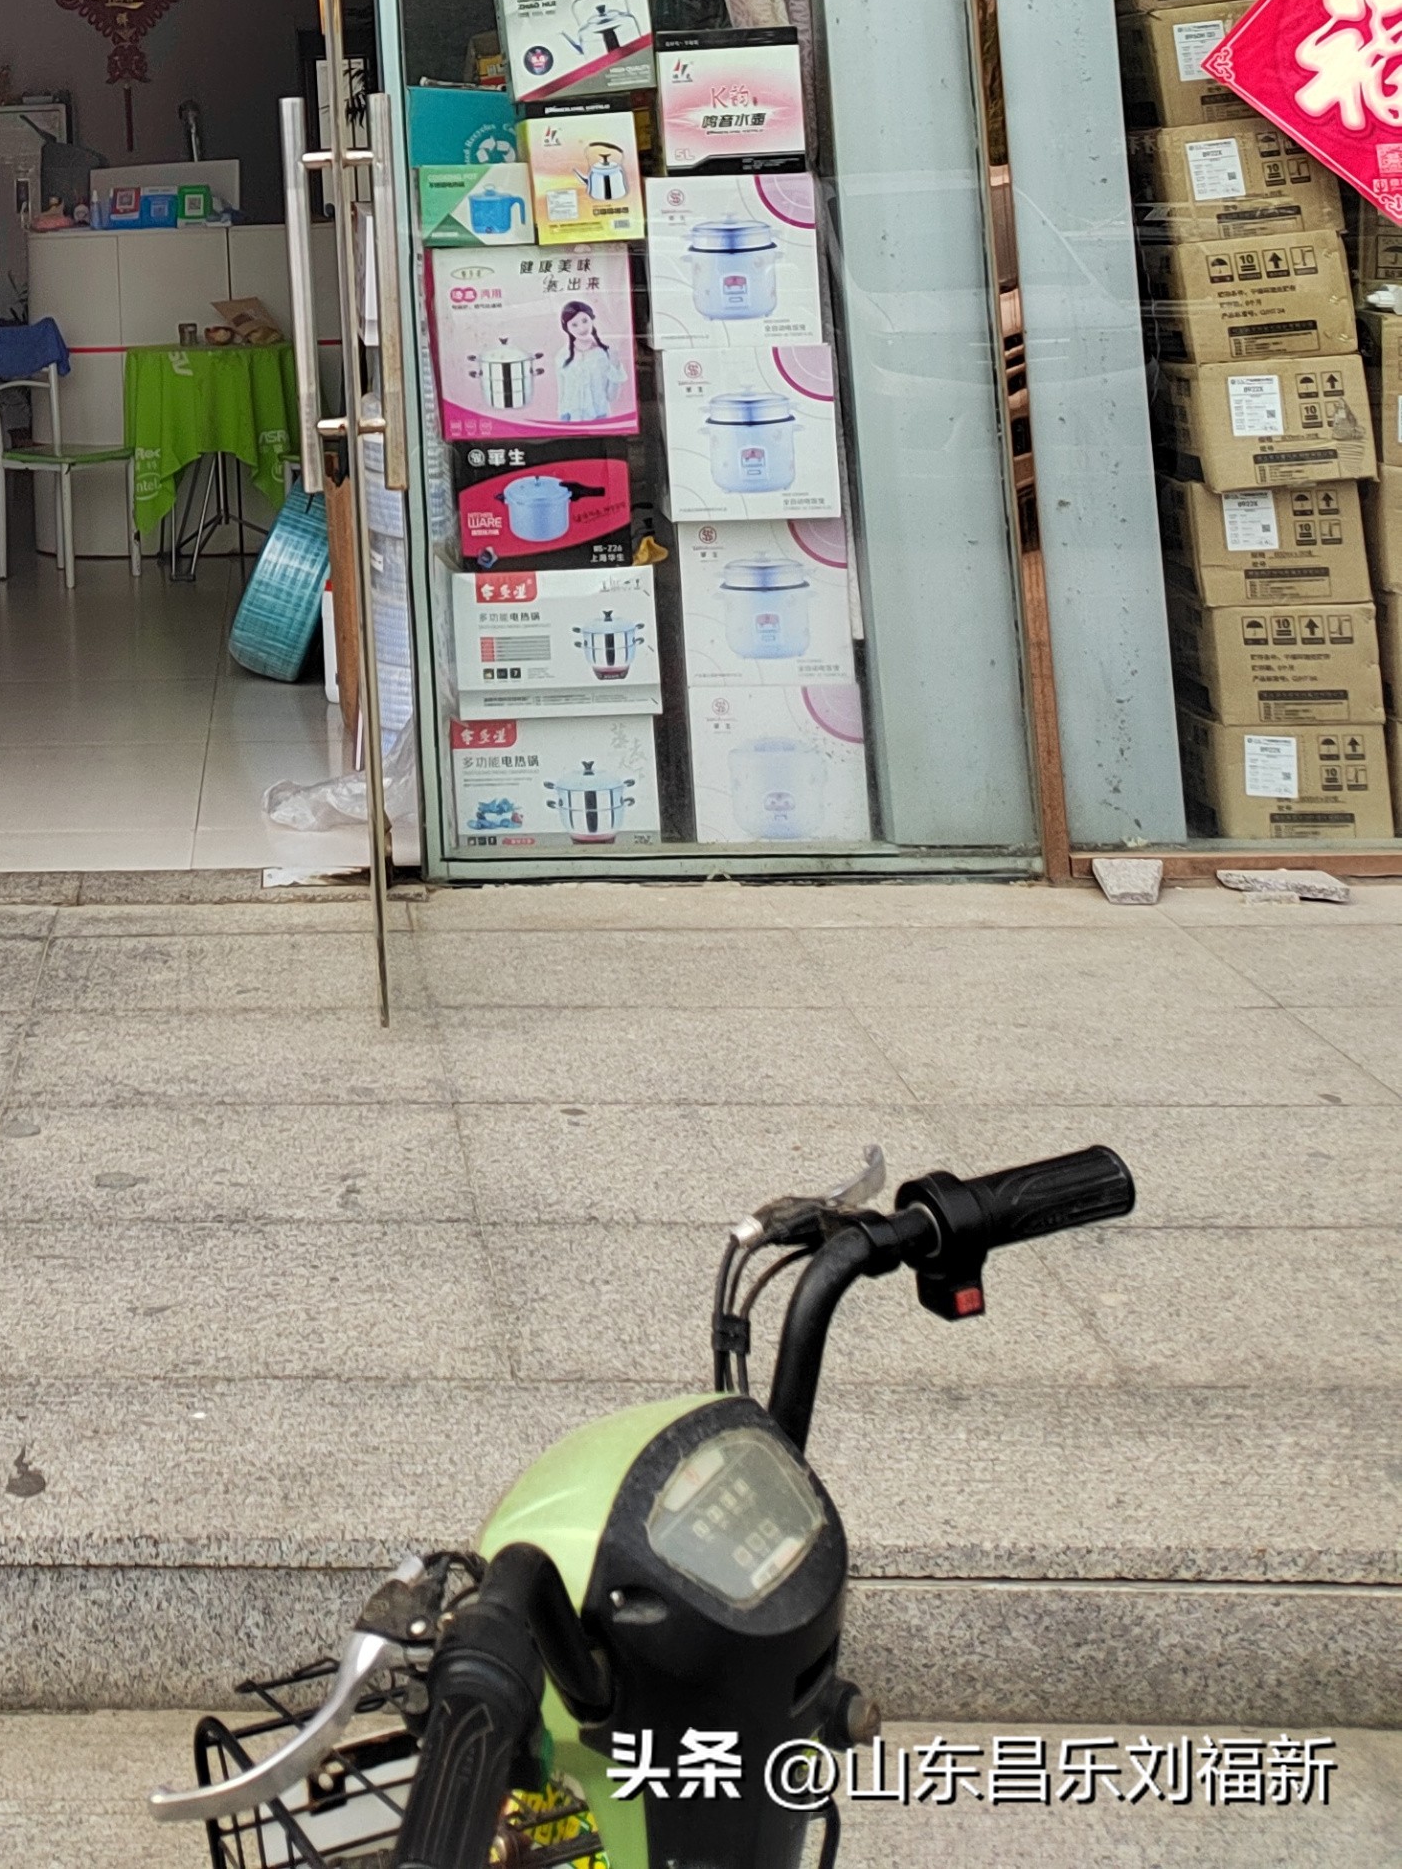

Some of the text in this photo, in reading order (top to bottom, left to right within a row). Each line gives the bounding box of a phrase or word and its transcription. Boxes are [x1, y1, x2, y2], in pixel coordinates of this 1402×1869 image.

[701, 112, 767, 129] 鸣音水壶
[1266, 163, 1280, 174] 10
[1239, 254, 1255, 264] 10
[519, 257, 593, 274] 健康美味
[1304, 405, 1318, 415] 10
[1298, 523, 1312, 533] 10
[479, 612, 541, 623] 多功能电热锅
[1275, 618, 1290, 629] 10
[462, 754, 540, 769] 多功能电热锅
[1325, 768, 1338, 777] 10
